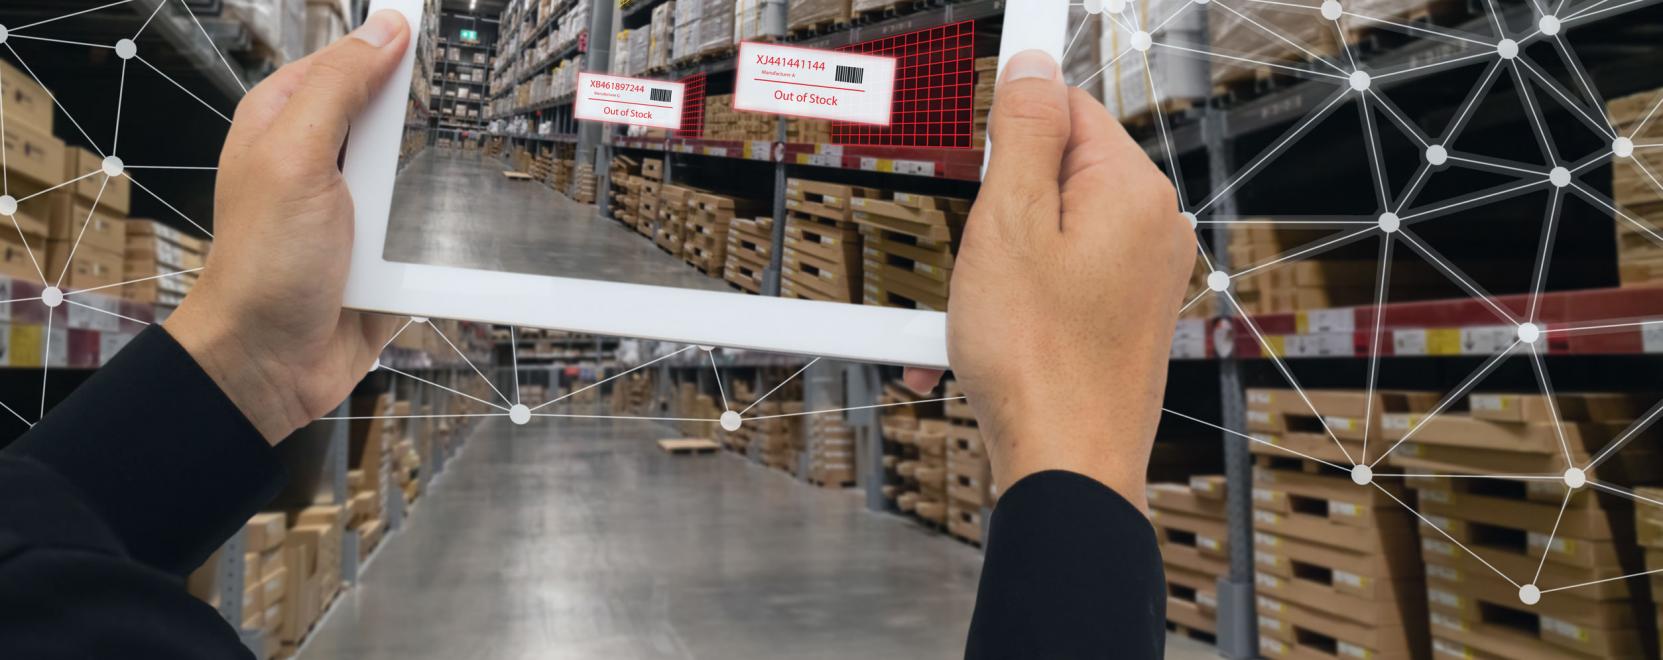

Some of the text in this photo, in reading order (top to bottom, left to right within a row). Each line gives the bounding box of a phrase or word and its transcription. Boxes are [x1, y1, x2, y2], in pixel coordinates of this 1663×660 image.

[756, 54, 825, 71] XJ441441144
[590, 80, 644, 92] XB461897244
[774, 90, 838, 106] Out of Stock
[603, 107, 619, 116] Out
[631, 110, 652, 119] Stock
